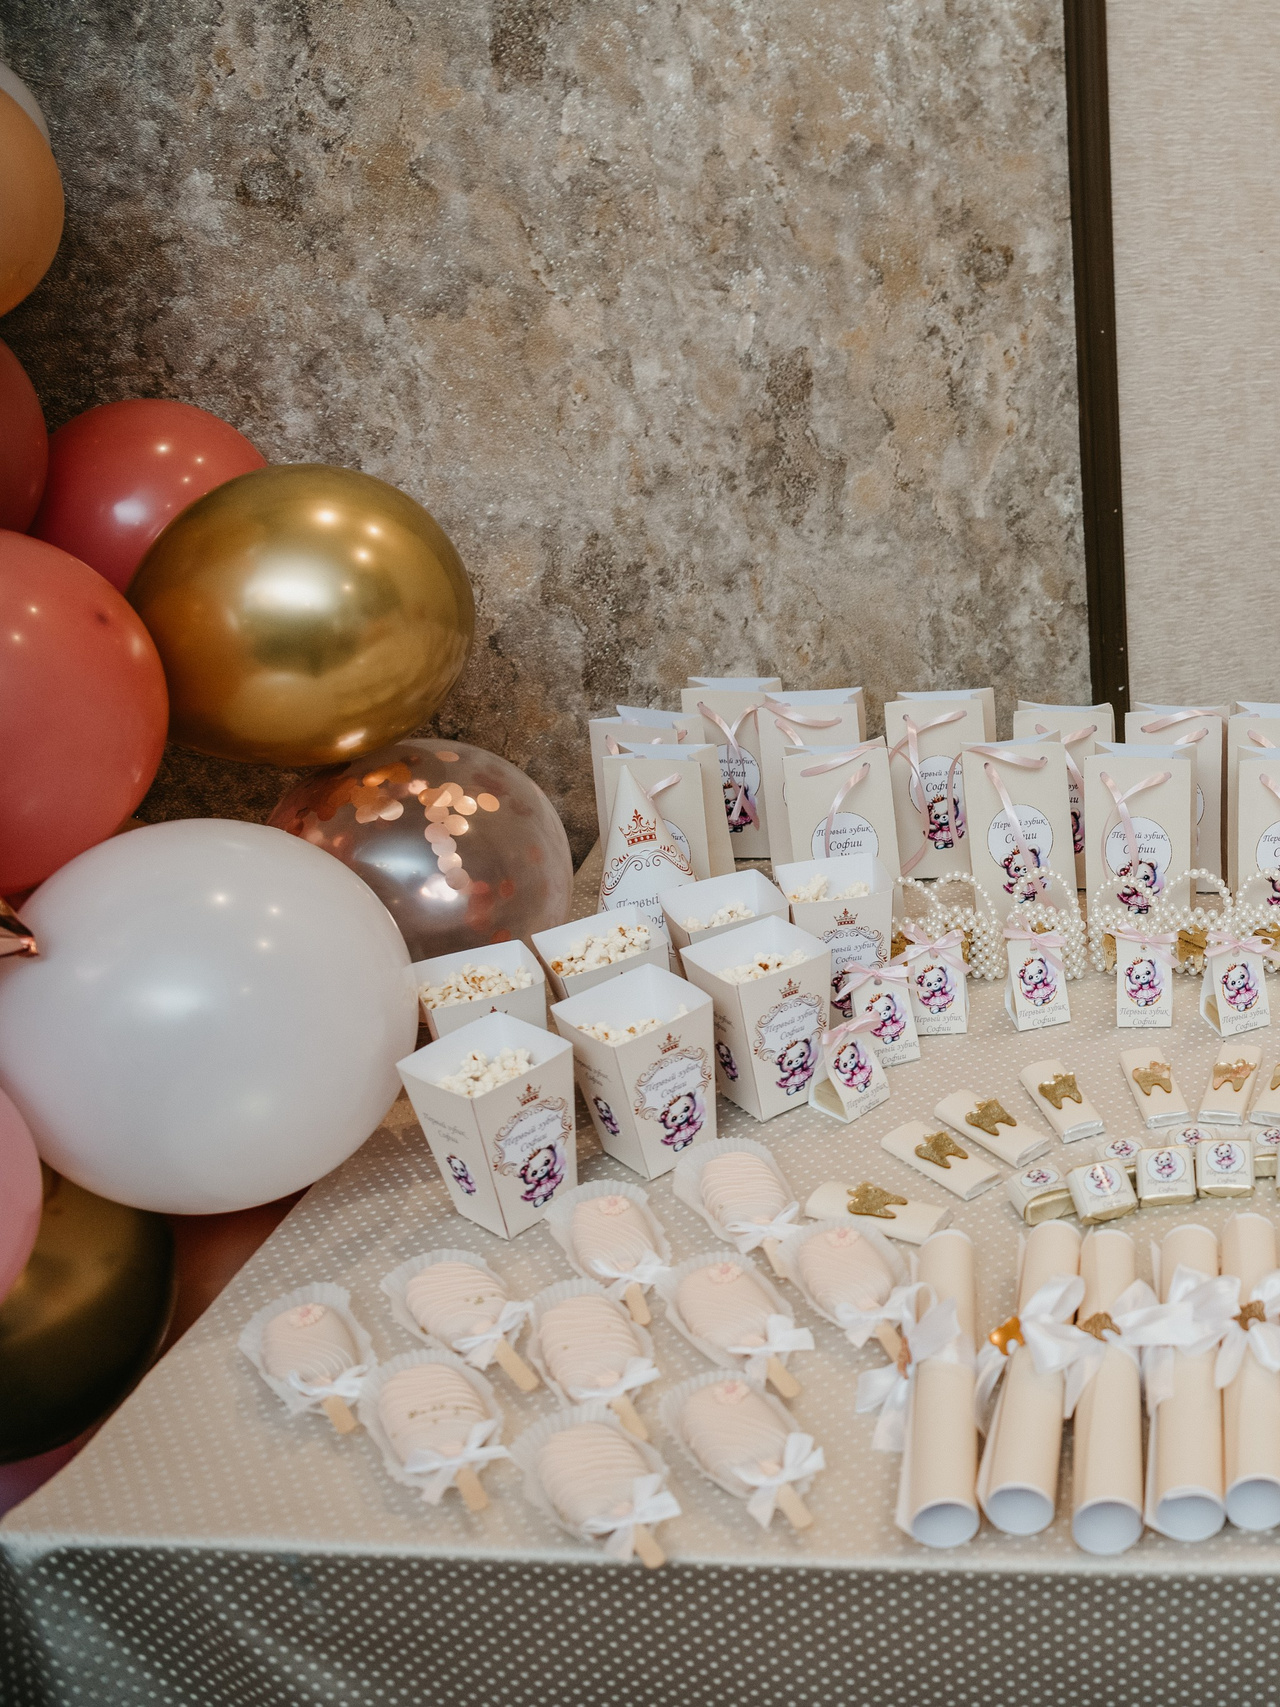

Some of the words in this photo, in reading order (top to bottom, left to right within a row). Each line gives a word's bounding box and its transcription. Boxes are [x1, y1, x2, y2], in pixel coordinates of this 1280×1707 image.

[1024, 817, 1048, 827] зубик
[816, 828, 848, 838] Пвый
[849, 824, 873, 836] зубик
[1143, 831, 1168, 841] зубик
[829, 838, 863, 852] Софии
[1119, 1007, 1148, 1017] Первый
[1148, 1006, 1171, 1017] зубик
[1132, 1016, 1157, 1027] Софии
